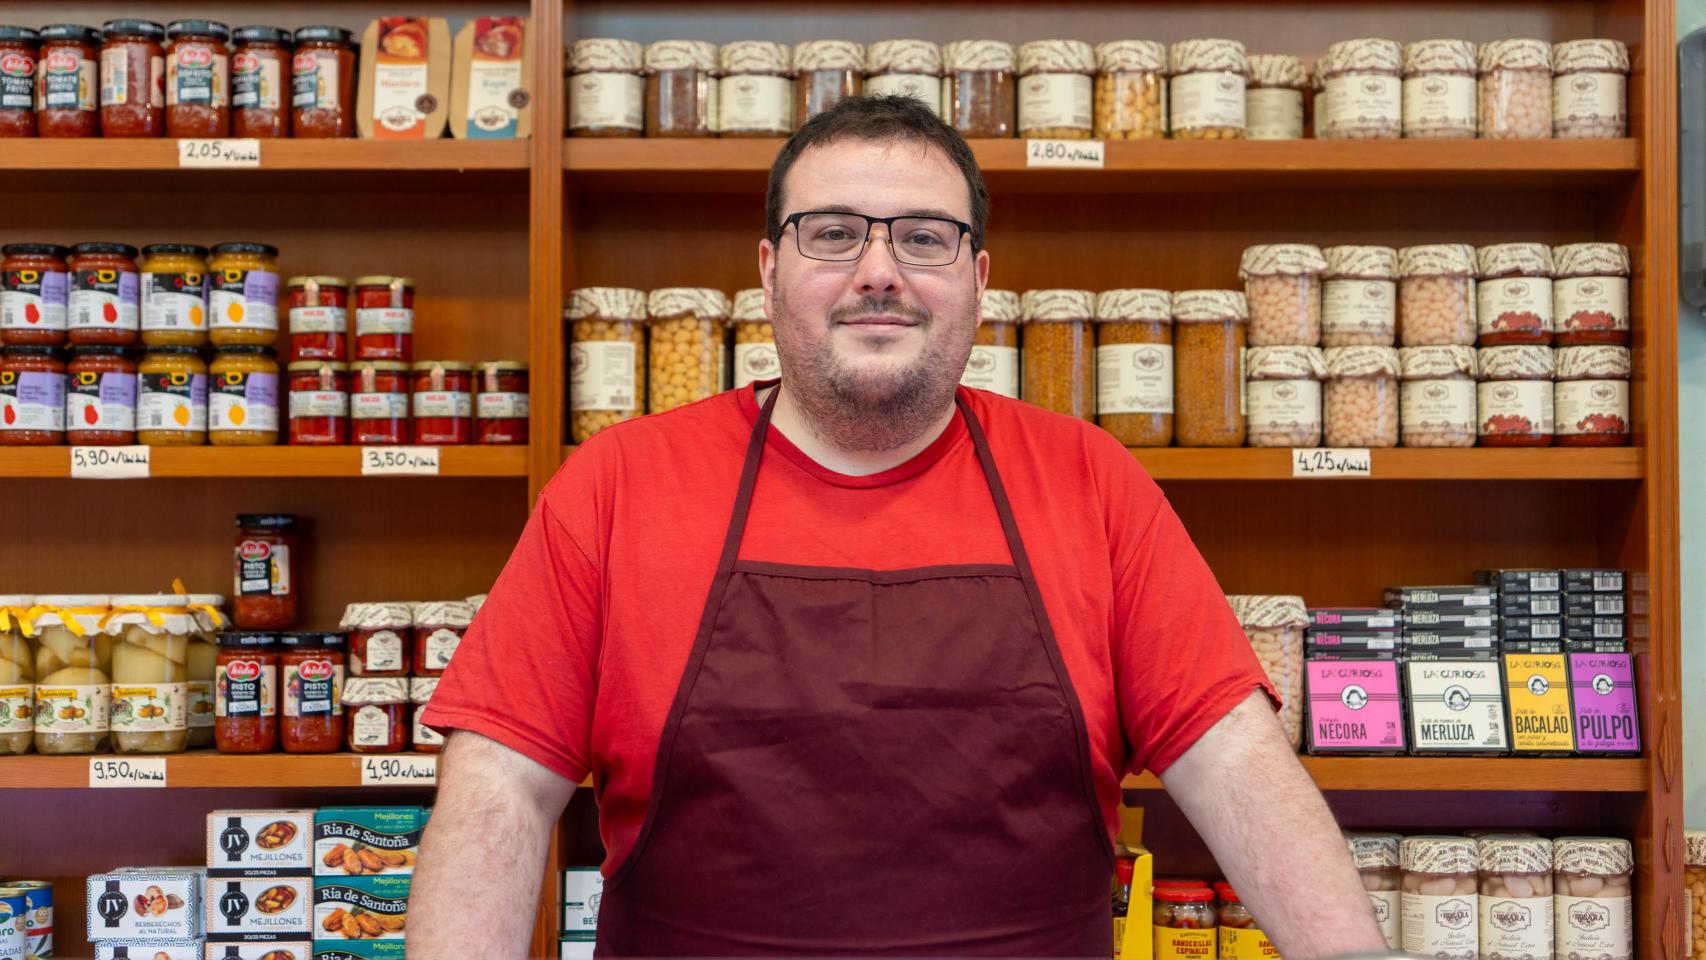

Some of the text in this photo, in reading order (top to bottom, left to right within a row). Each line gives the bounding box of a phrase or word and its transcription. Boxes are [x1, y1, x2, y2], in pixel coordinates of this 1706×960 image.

[1411, 592, 1440, 603] MERLUZA
[1412, 614, 1440, 624] MERLUZA
[1412, 635, 1440, 645] MERLUZA
[1319, 720, 1368, 740] NÉCORA
[1386, 721, 1396, 729] SIN
[1515, 716, 1568, 734] BACALAO
[1579, 715, 1633, 740] PULPO
[1420, 724, 1474, 740] MERLUZA
[94, 760, 130, 780] 9,50
[366, 759, 400, 781] 4,90
[374, 813, 414, 822] Mejillones
[346, 826, 360, 838] de
[361, 830, 409, 848] Santoña
[250, 853, 302, 861] MEJILLONES
[373, 878, 410, 886] Mejillone
[344, 890, 358, 902] de
[360, 896, 407, 912] Santoña
[373, 943, 404, 952] Mejillon
